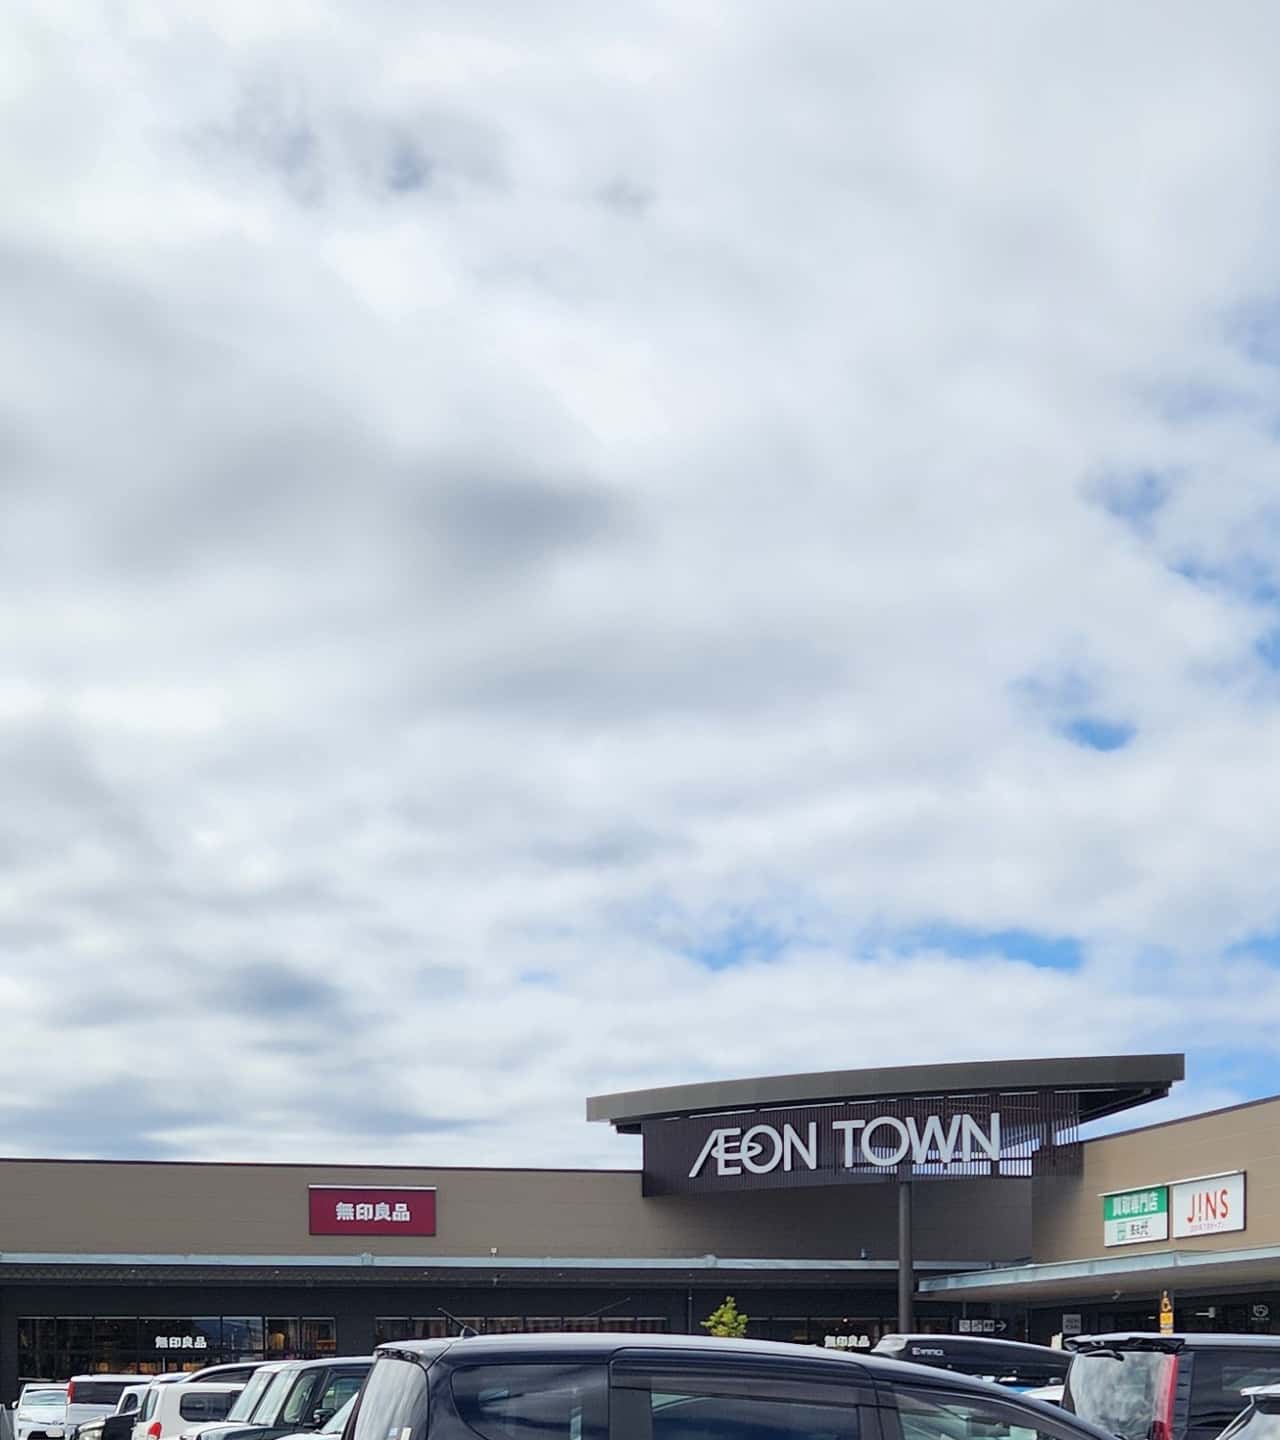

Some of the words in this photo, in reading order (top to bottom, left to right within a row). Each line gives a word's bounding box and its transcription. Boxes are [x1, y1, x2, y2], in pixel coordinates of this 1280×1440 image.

[832, 1113, 1001, 1168] TOWN
[336, 1202, 411, 1222] 無印良品
[155, 1336, 208, 1349] 無印良品
[824, 1335, 871, 1348] 無印良品
